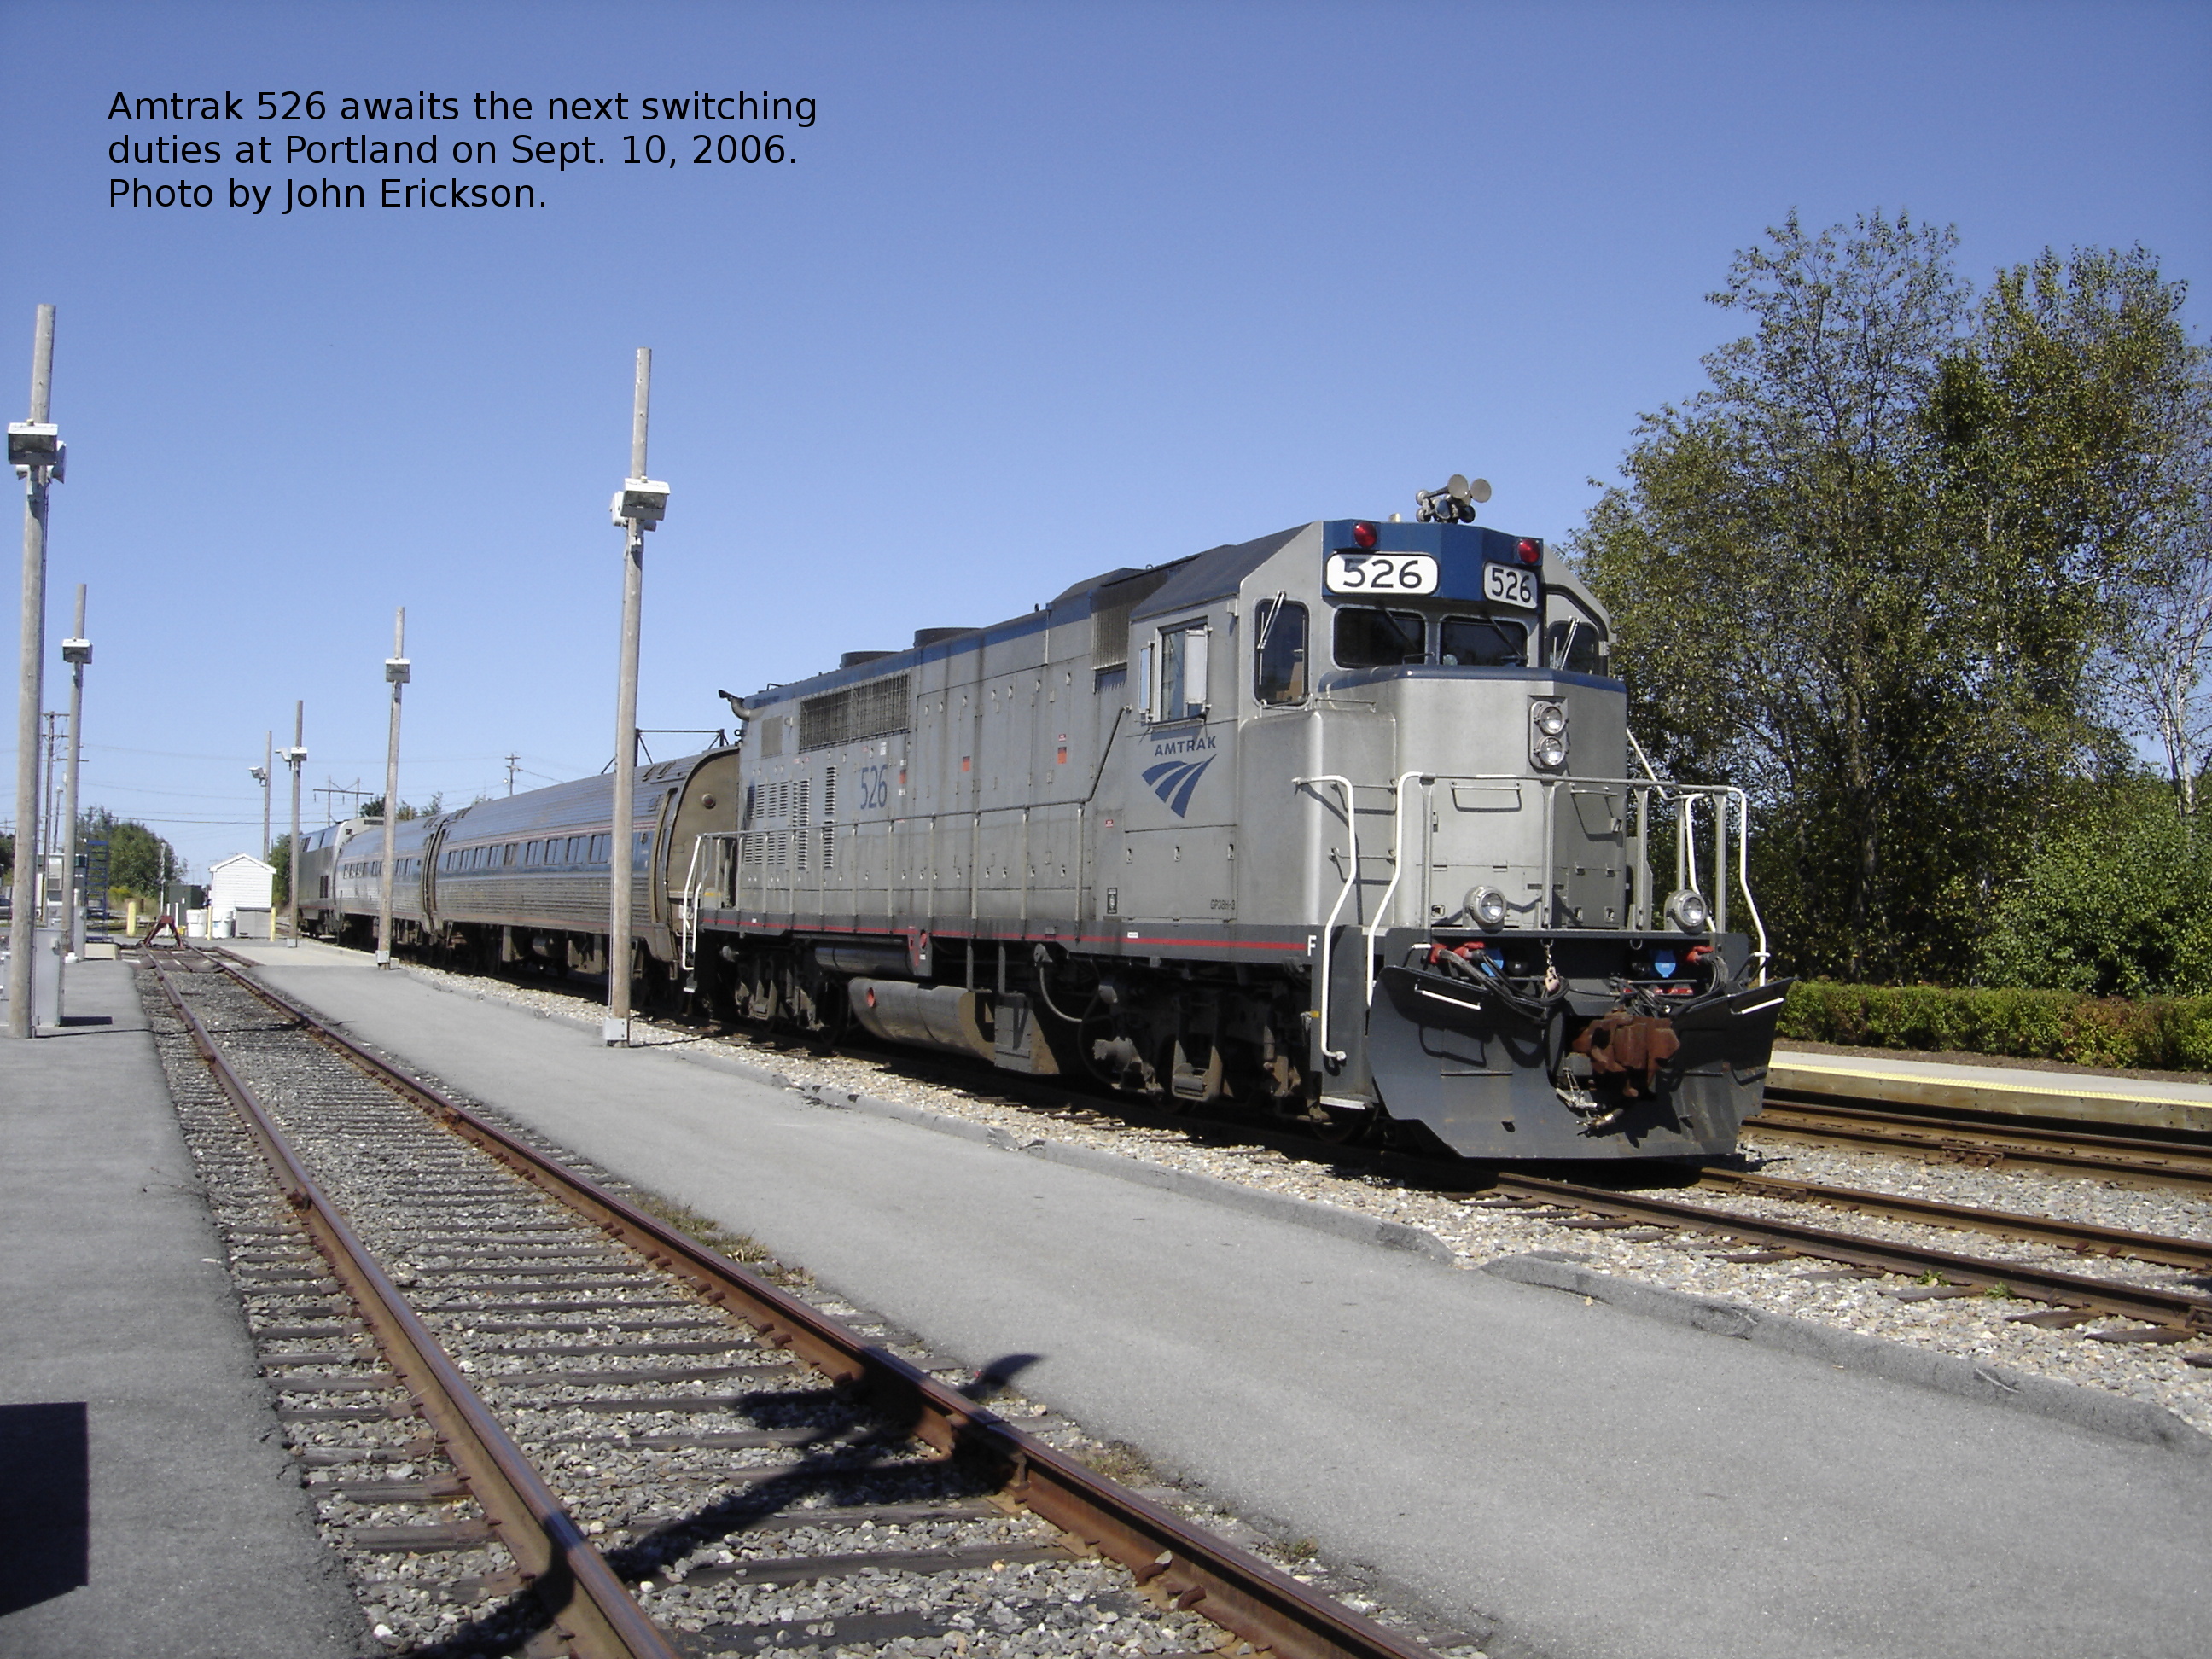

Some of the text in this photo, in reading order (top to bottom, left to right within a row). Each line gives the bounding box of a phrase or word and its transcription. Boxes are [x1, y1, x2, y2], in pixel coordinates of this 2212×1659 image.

[1342, 558, 1423, 589] 526
[1491, 567, 1532, 603] 526
[1154, 736, 1217, 757] AMTRAK
[860, 764, 888, 810] 526
[1307, 934, 1317, 956] F
